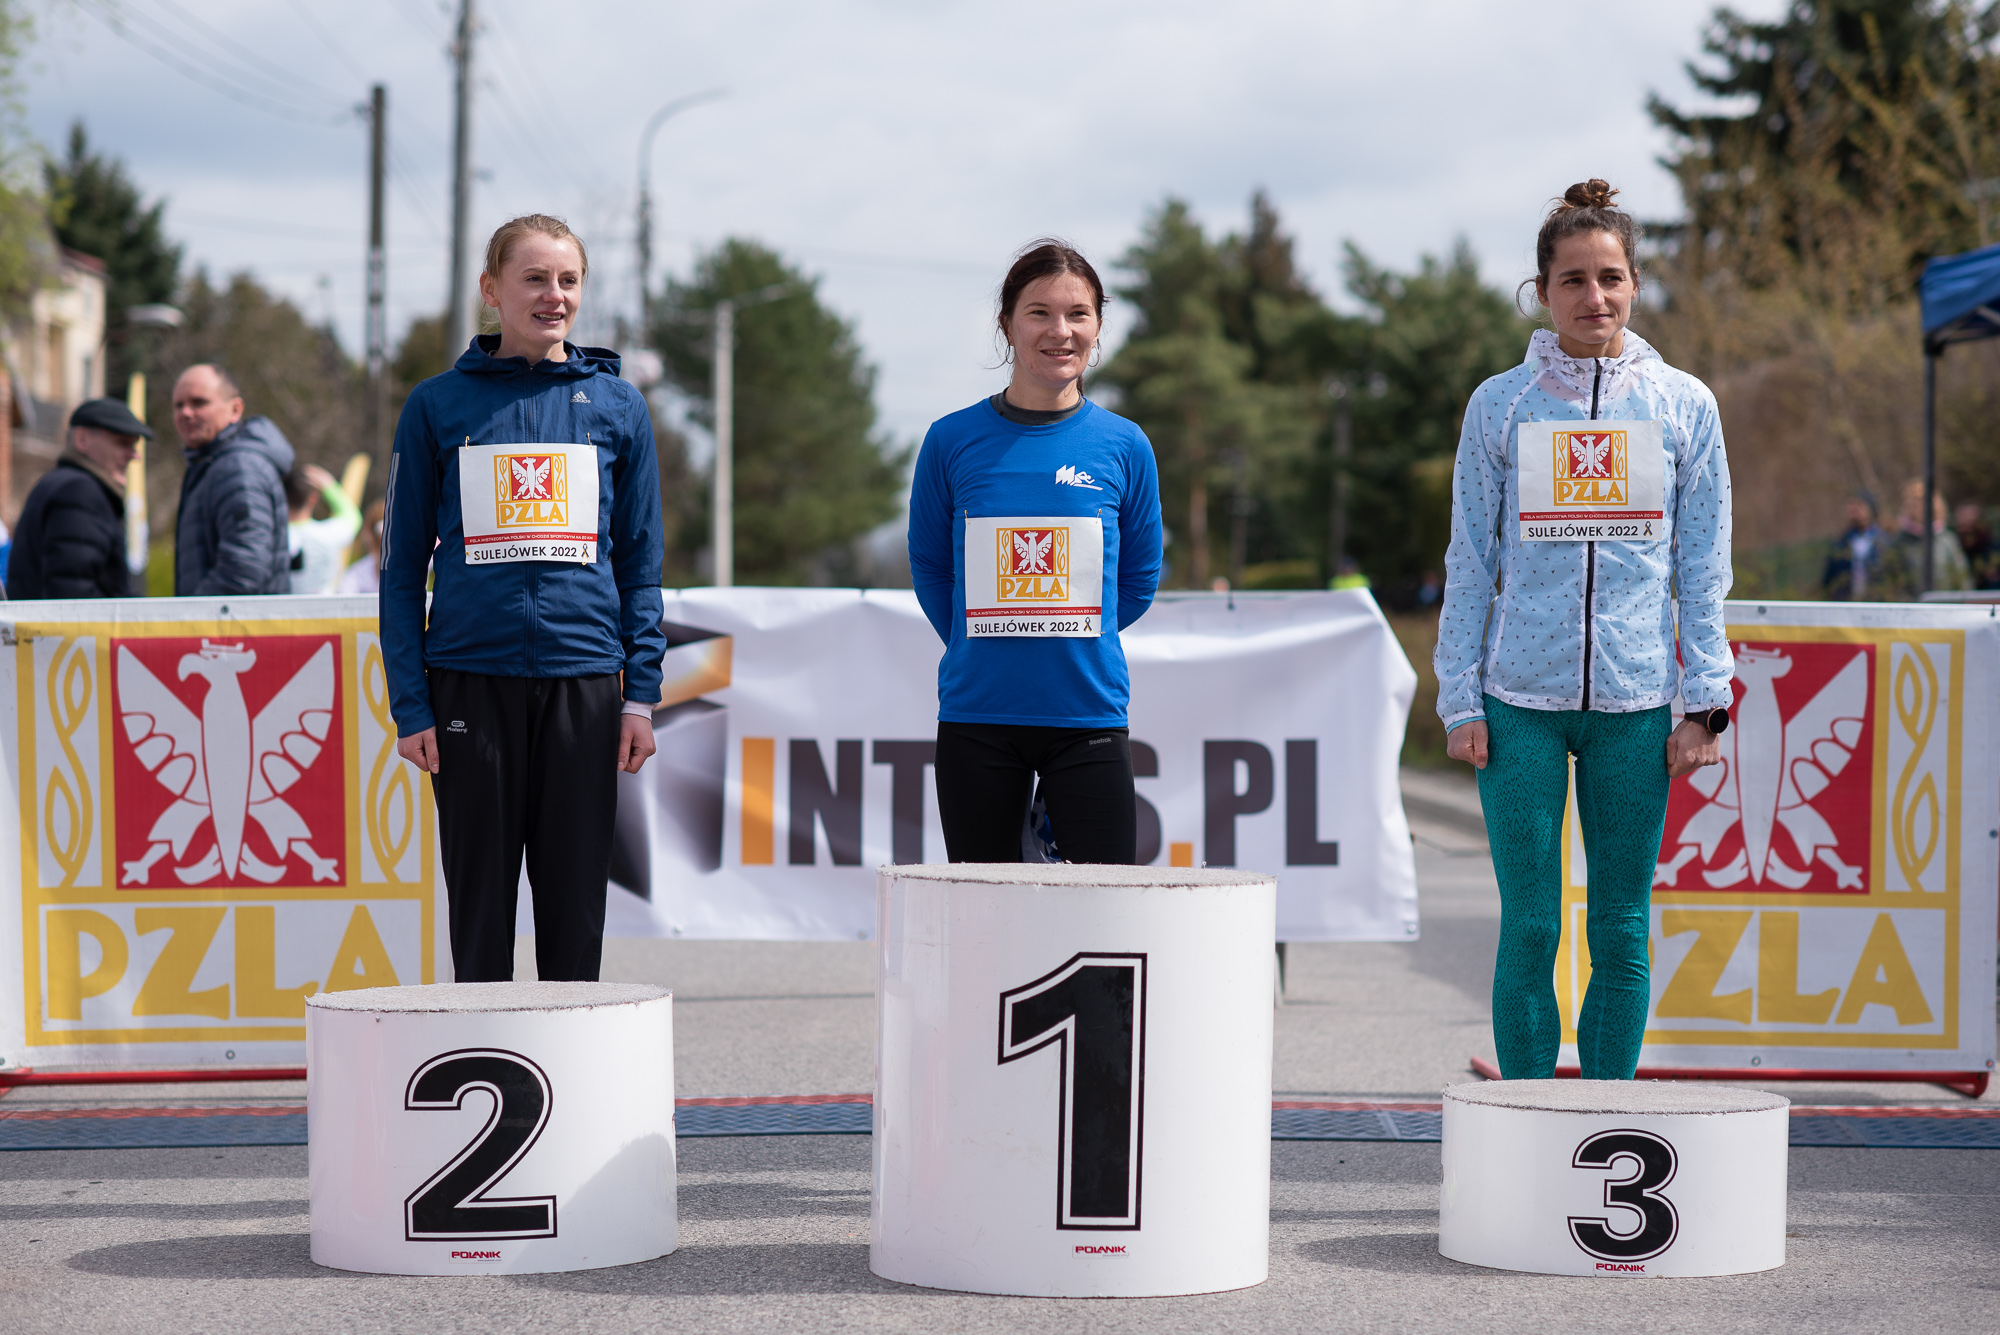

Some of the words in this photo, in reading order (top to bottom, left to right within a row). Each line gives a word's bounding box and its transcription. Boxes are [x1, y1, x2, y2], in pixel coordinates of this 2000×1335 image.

[1558, 481, 1624, 502] PZLA
[500, 503, 564, 524] PZLA
[1528, 524, 1603, 538] SULEJÓWEK
[1608, 526, 1638, 536] 2022
[474, 545, 546, 560] SULEJÓWEK
[550, 546, 577, 558] 2022
[1001, 578, 1064, 598] PZLA
[974, 620, 1045, 634] SULEJÓWEK
[1050, 622, 1078, 632] 2022
[1088, 737, 1112, 746] Reebok
[46, 904, 402, 1022] PZLA
[998, 952, 1148, 1232] 1
[404, 1048, 558, 1242] 2
[1567, 1128, 1680, 1263] 3
[452, 1250, 502, 1259] POLANIK
[1075, 1246, 1126, 1254] POLANIK
[1596, 1262, 1646, 1272] POLANIK
